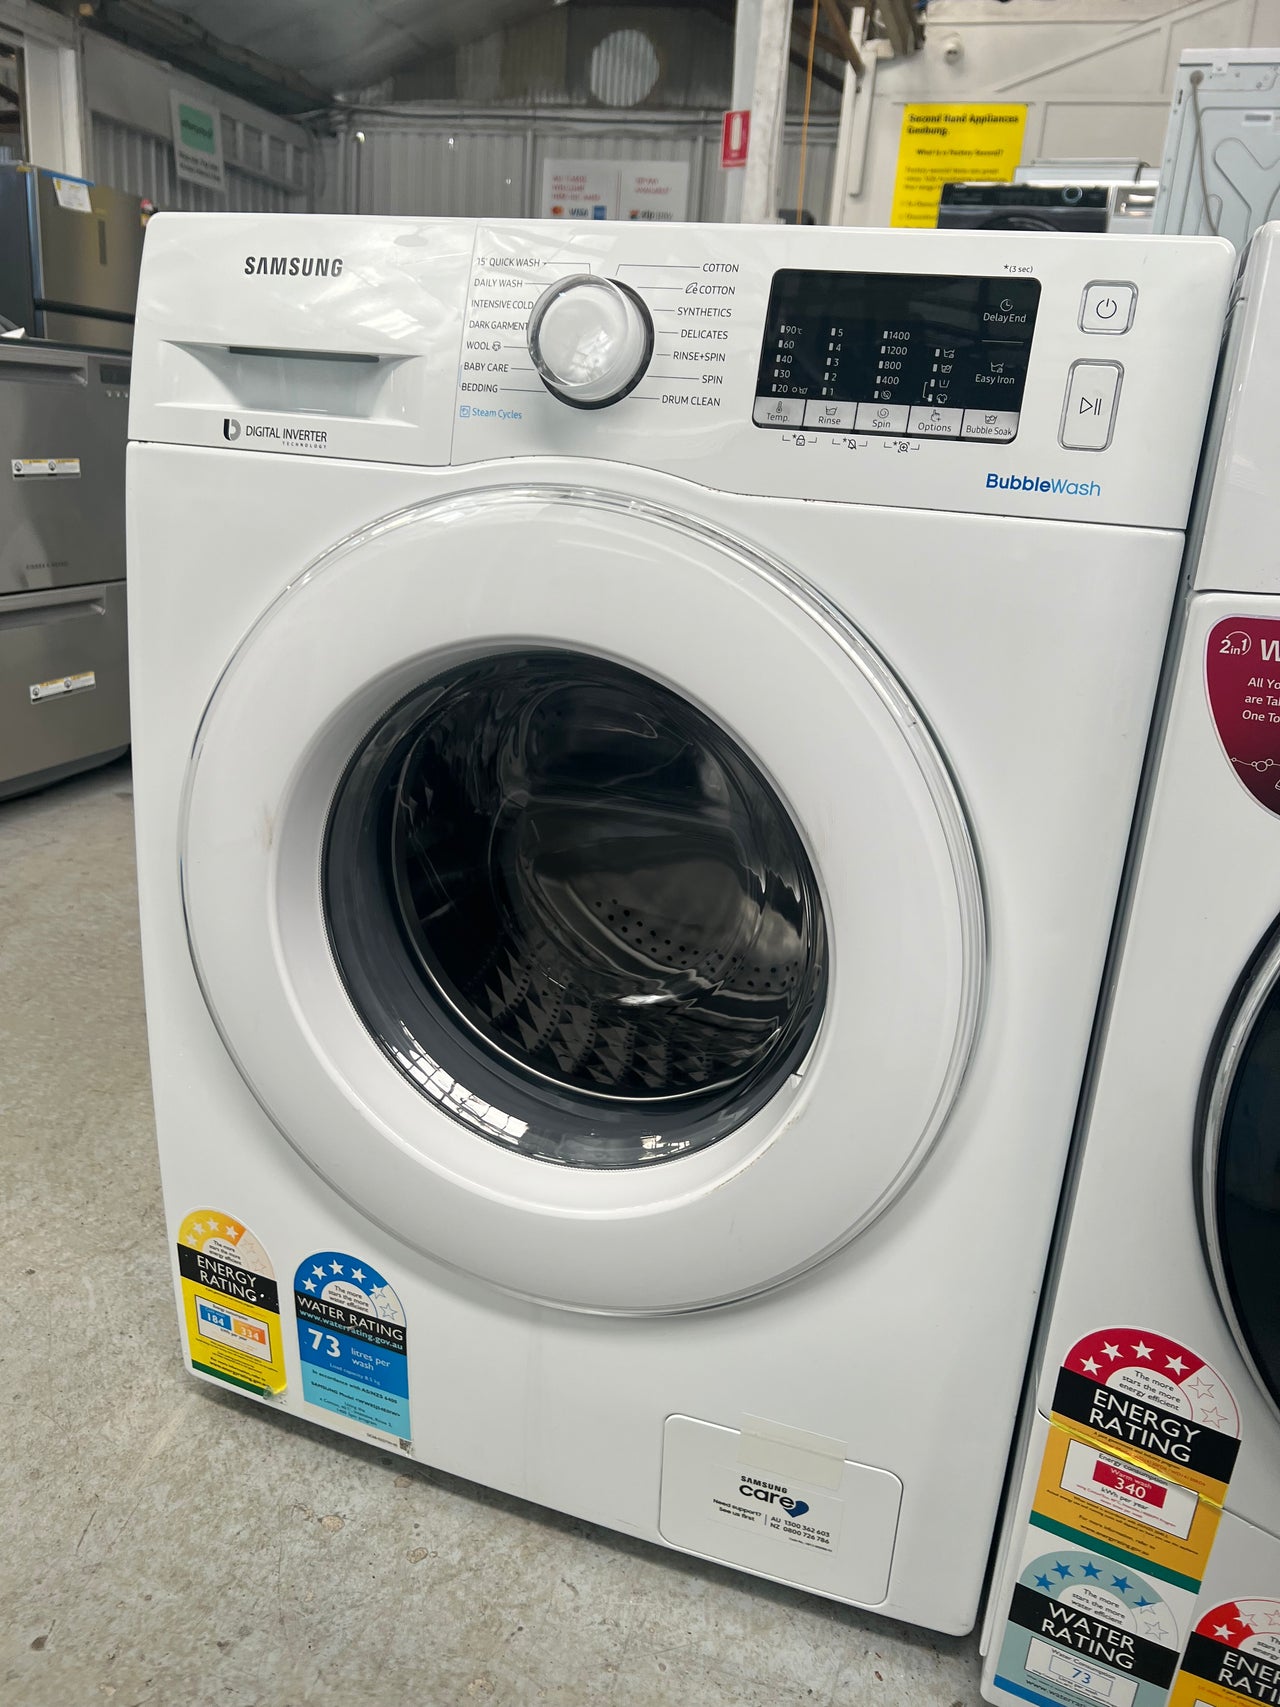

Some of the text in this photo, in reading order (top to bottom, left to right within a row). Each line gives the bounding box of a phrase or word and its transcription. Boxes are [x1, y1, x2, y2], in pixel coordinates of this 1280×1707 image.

[969, 113, 1019, 125] Appliances
[244, 256, 344, 277] SAMSUNG
[489, 258, 514, 267] QUICK
[515, 258, 540, 267] WASH
[702, 263, 740, 273] COTTON
[473, 278, 523, 288] DAILY WASH
[699, 285, 736, 295] COTTON
[471, 299, 534, 310] INTENSIVE COLD
[677, 306, 732, 317] SYNTHETICS
[468, 320, 528, 331] DARK GARMENT
[680, 329, 729, 340] DELICATES
[837, 328, 844, 337] 5
[888, 331, 911, 342] 1400
[466, 341, 490, 350] WOOL
[783, 340, 795, 349] 60
[836, 343, 842, 351] 4
[673, 351, 726, 362] RINSE+SPIN
[886, 346, 908, 356] 1200
[781, 355, 793, 364] 40
[834, 358, 840, 367] 3
[884, 361, 902, 370] 800
[463, 362, 509, 372] BABY CARE
[701, 374, 723, 384] SPIN
[779, 370, 791, 379] 30
[831, 372, 838, 381] 2
[881, 376, 900, 385] 400
[975, 374, 1015, 386] Easy Iron
[461, 383, 498, 393] BEDDING
[777, 384, 789, 393] 20
[662, 395, 721, 407] DRUM CLEAN
[472, 409, 522, 420] Steam Cycles
[818, 415, 841, 425] Rinse
[871, 419, 891, 430] Spin
[917, 422, 952, 433] Options
[966, 425, 1013, 436] Bubble Soak
[245, 425, 328, 443] DIGITAL INVERTER
[282, 441, 328, 449] TECHNOLOGY
[985, 473, 1101, 496] BubbleWash
[1247, 677, 1264, 688] All
[1244, 695, 1280, 707] are Ta
[1242, 709, 1265, 722] One
[196, 1254, 257, 1288] ENERGY
[200, 1270, 257, 1302] RATING
[334, 1284, 363, 1300] The more
[328, 1290, 370, 1308] stars the more
[206, 1312, 225, 1327] 184
[297, 1295, 404, 1341] WATER RATING
[240, 1326, 260, 1341] 334
[307, 1327, 341, 1358] 73
[351, 1347, 391, 1368] litres per
[351, 1358, 374, 1371] wash
[1134, 1369, 1174, 1392] The more
[1121, 1374, 1181, 1404] stars the more
[1119, 1381, 1180, 1412] energy efficient
[1093, 1388, 1202, 1444] ENERGY
[1089, 1407, 1192, 1463] RATING
[1098, 1453, 1121, 1469] Energy
[740, 1475, 788, 1494] SAMSUNG
[1110, 1467, 1153, 1490] Warm wash
[1114, 1477, 1147, 1500] 340
[738, 1484, 795, 1509] care
[1100, 1486, 1150, 1511] kWh per year
[712, 1498, 731, 1508] Need
[718, 1506, 732, 1515] See
[741, 1512, 755, 1522] first
[769, 1522, 781, 1530] NZ
[783, 1526, 802, 1536] 0800
[802, 1531, 816, 1541] 726
[816, 1535, 830, 1545] 786
[784, 1519, 801, 1530] 1300
[802, 1524, 815, 1534] 362
[816, 1528, 830, 1538] 603
[1083, 1587, 1120, 1609] The more
[1071, 1598, 1124, 1626] water efficient
[1072, 1592, 1126, 1620] stars the more
[1048, 1601, 1136, 1654] WATER
[1041, 1617, 1135, 1671] RATING
[1050, 1647, 1074, 1663] Water
[1072, 1667, 1092, 1685] 73
[1217, 1667, 1280, 1706] RATI
